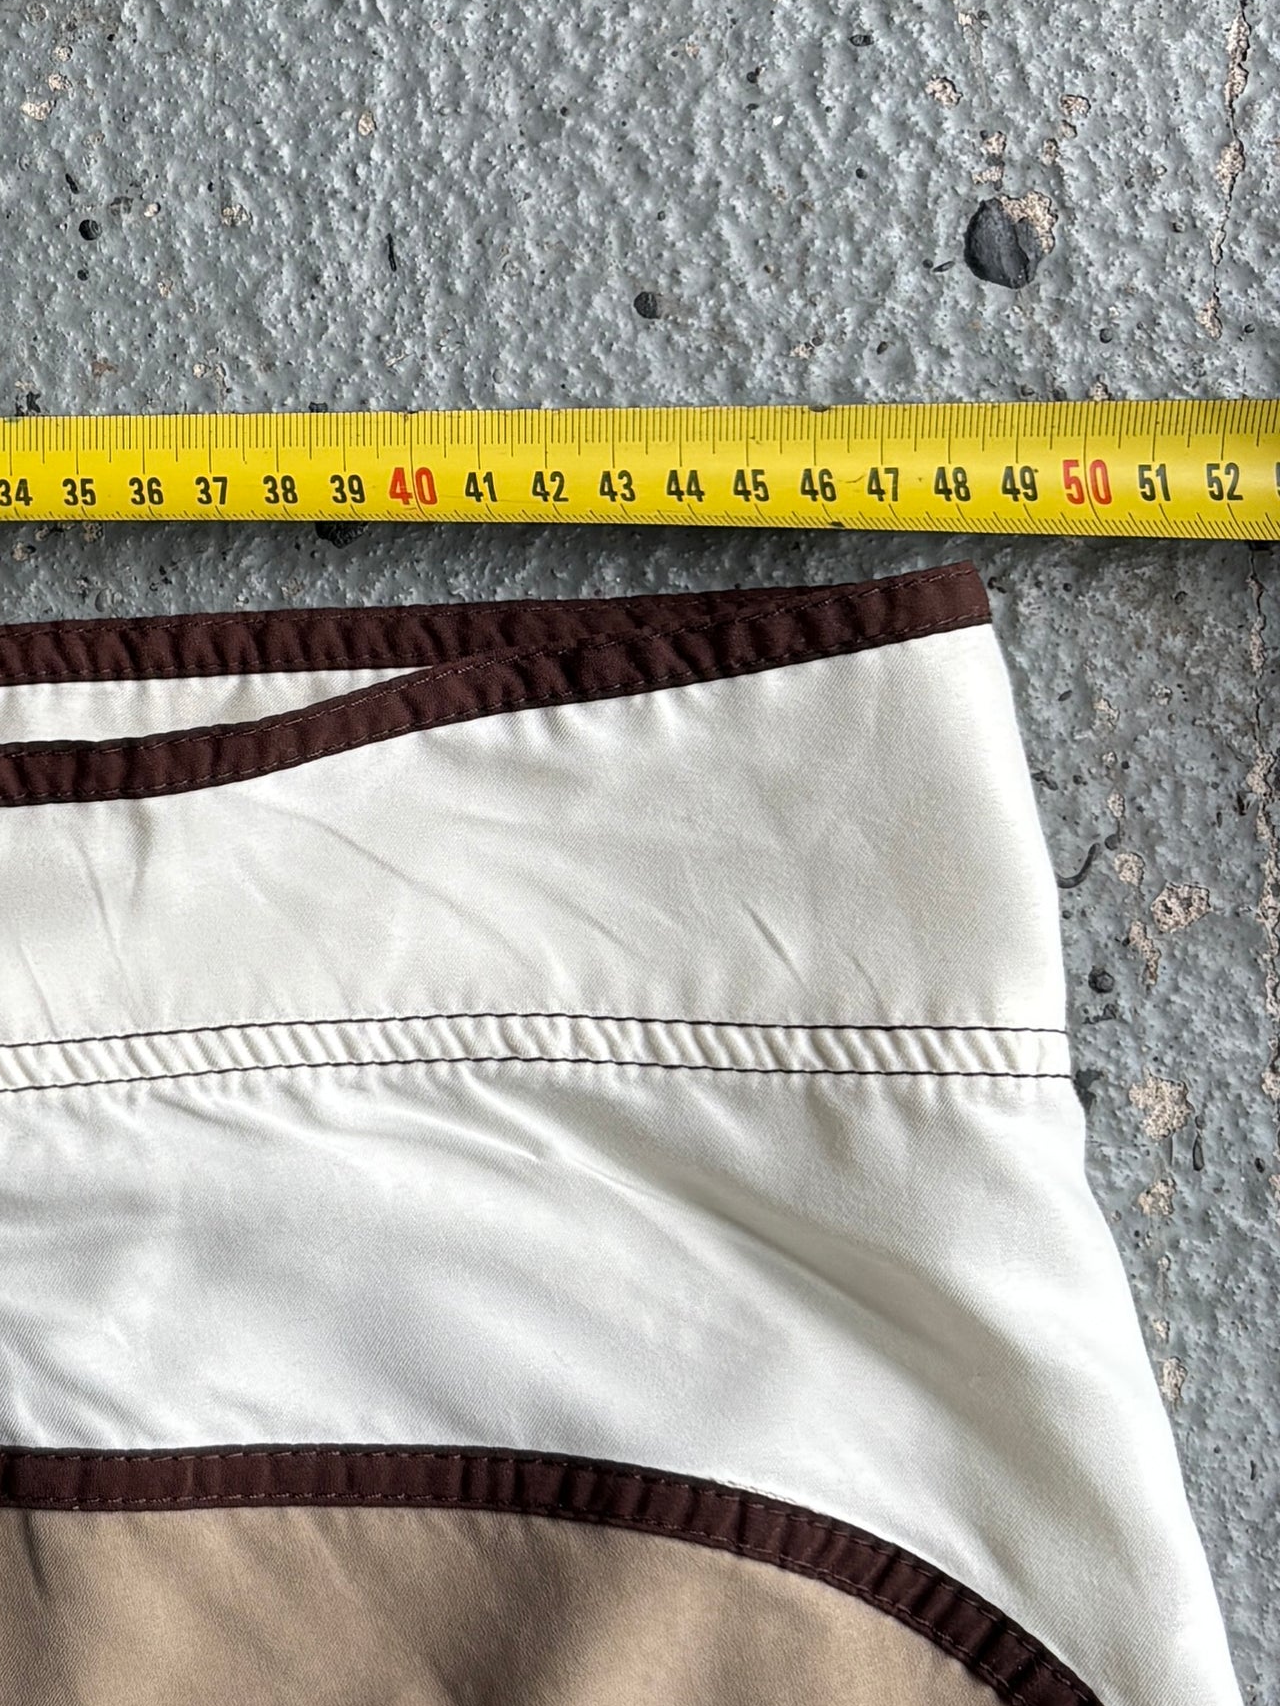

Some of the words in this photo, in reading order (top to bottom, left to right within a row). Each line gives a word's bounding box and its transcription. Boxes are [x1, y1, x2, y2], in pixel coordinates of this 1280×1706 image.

[62, 478, 96, 506] 35
[129, 477, 164, 505] 36
[195, 476, 228, 505] 37
[263, 475, 298, 504] 38
[330, 474, 366, 504] 39
[389, 467, 438, 505] 40
[465, 471, 498, 503] 41
[531, 471, 569, 502] 42
[599, 470, 636, 502] 43
[666, 469, 705, 503] 44
[733, 469, 770, 502] 45
[800, 468, 837, 502] 46
[867, 467, 899, 502] 47
[934, 466, 971, 502] 48
[1001, 465, 1038, 502] 49
[1063, 459, 1112, 505] 50
[1138, 463, 1171, 502] 51
[1206, 462, 1244, 501] 52
